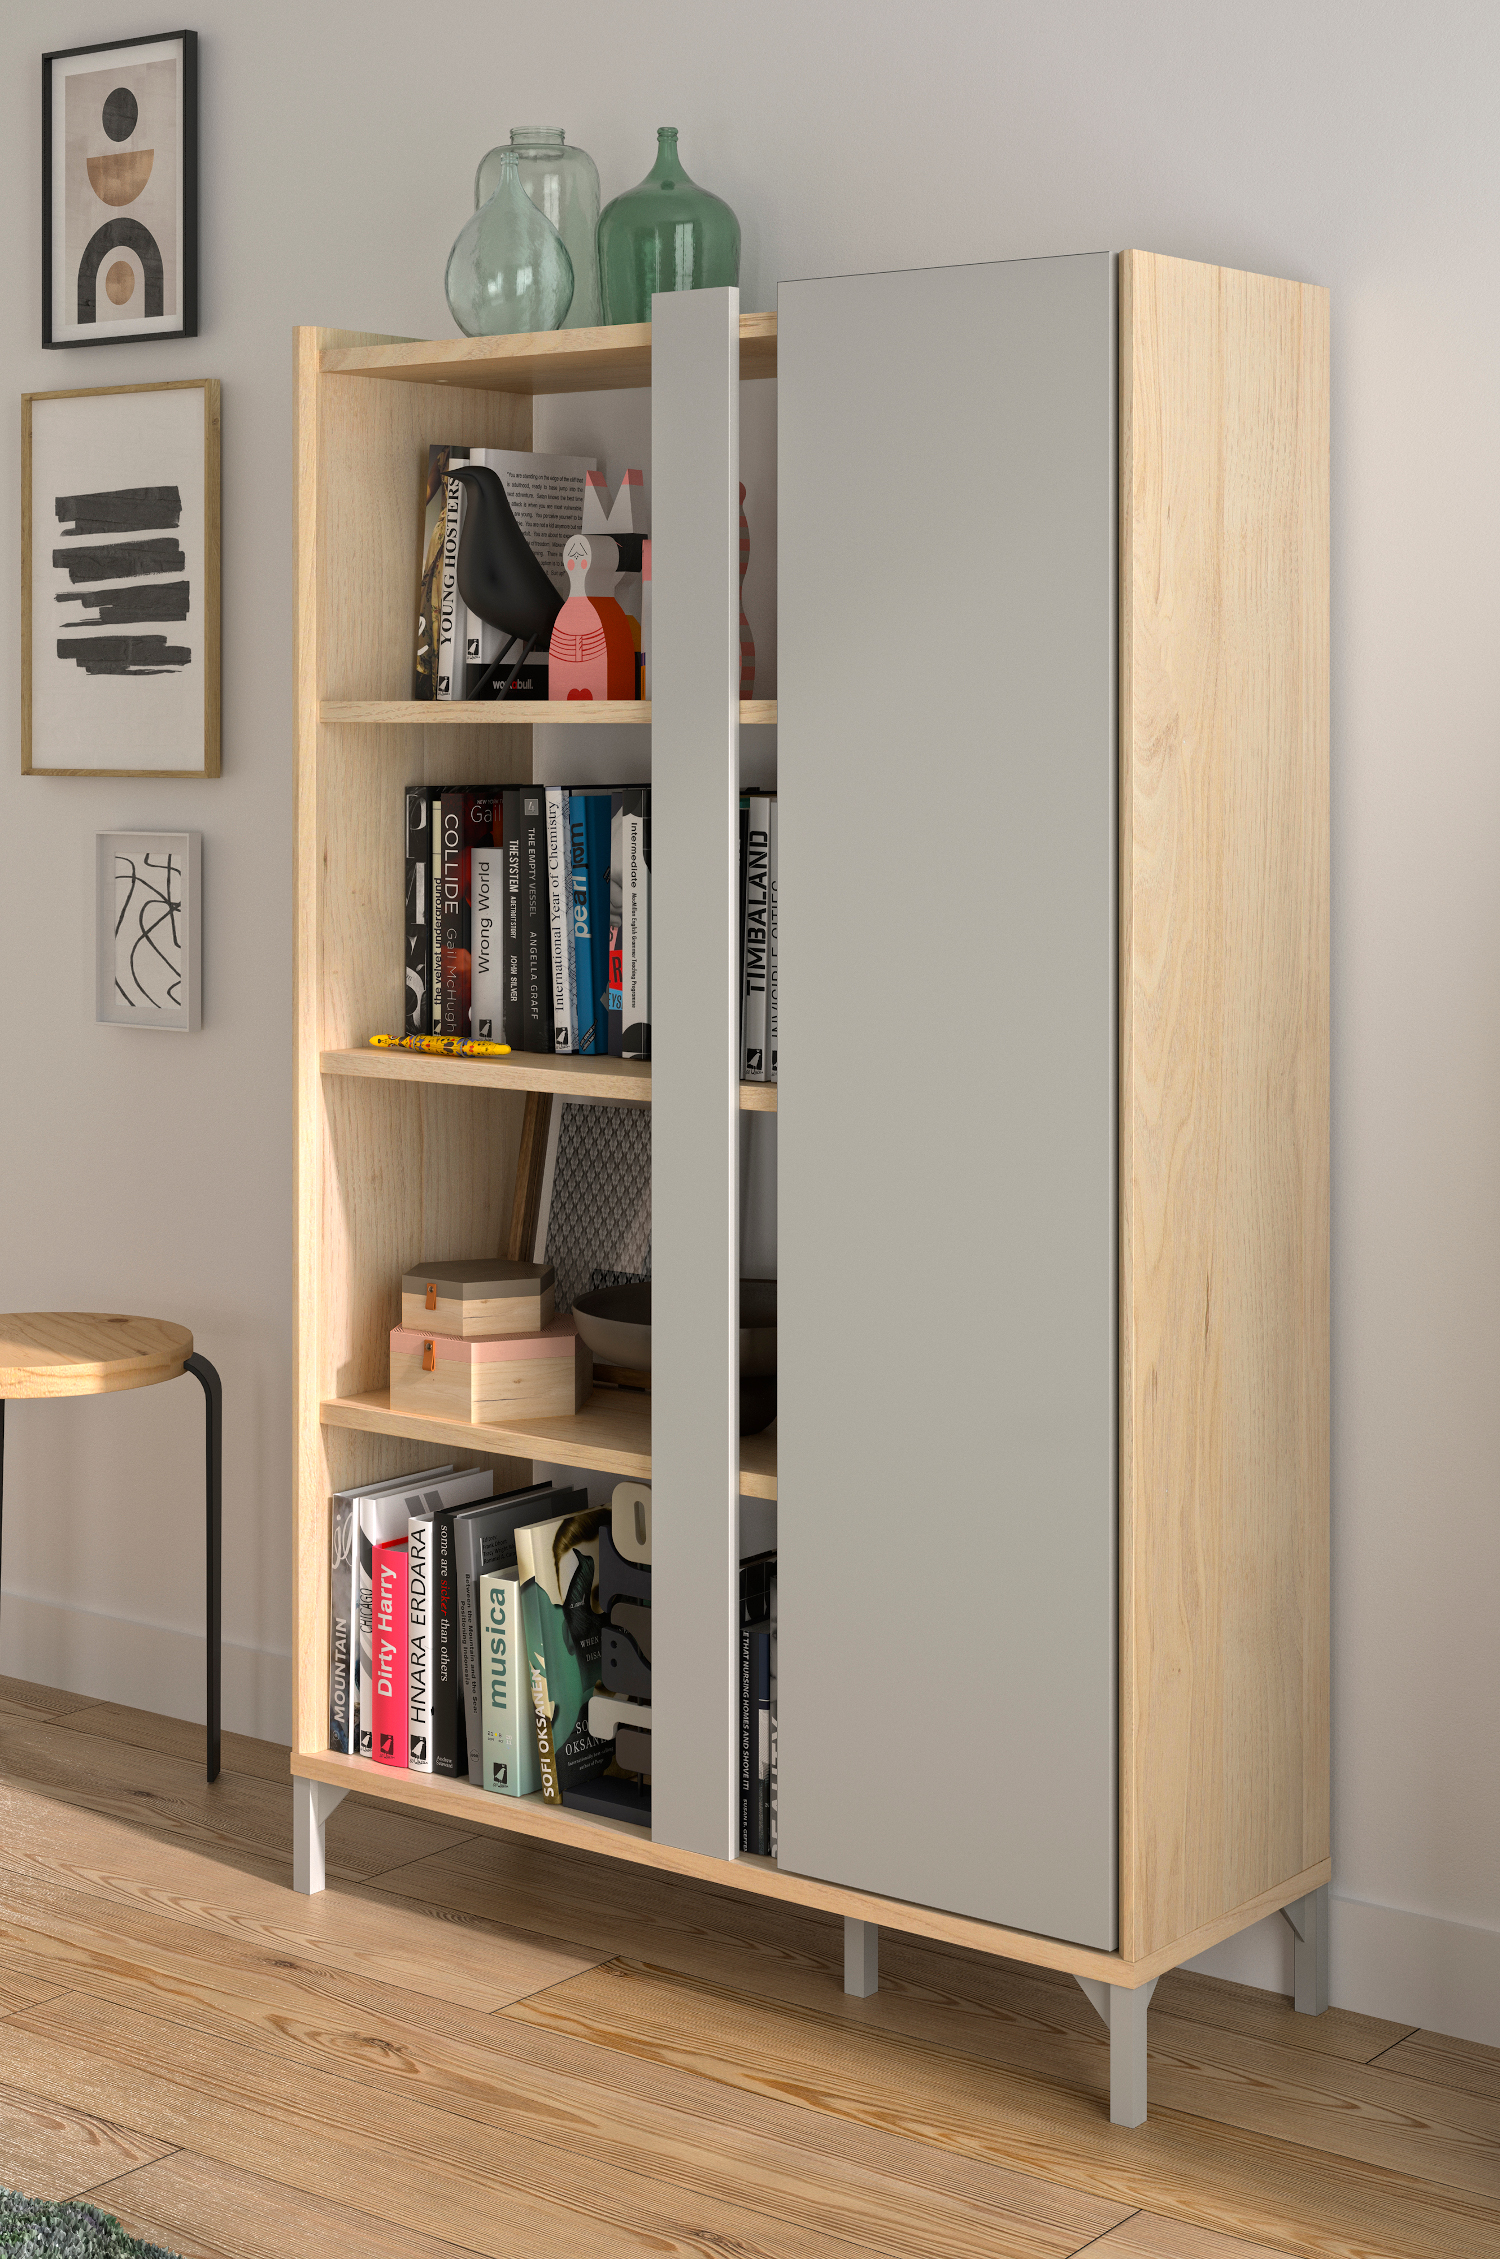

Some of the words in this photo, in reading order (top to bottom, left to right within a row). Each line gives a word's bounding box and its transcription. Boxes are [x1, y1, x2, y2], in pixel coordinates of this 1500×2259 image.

[444, 476, 459, 569] HOSTERS
[440, 574, 456, 646] YOUNG
[492, 678, 534, 690] woabull.
[470, 804, 501, 823] Gail
[509, 840, 519, 856] THE
[528, 828, 536, 846] THE
[548, 801, 560, 870] Chemistry
[570, 822, 589, 870] jam
[444, 813, 459, 914] COLLIDE
[528, 849, 536, 881] EMPTY
[630, 822, 638, 888] Intermediate
[478, 862, 490, 911] World
[509, 857, 519, 893] SYSTEM
[550, 874, 559, 888] of
[528, 882, 537, 917] VESSEL
[551, 892, 560, 922] Year
[571, 876, 592, 939] pearl
[746, 830, 768, 997] TIMBALAND
[446, 928, 458, 959] Gail
[479, 917, 493, 974] Wrong
[529, 931, 538, 981] ANGELLA
[433, 951, 441, 985] velvet
[510, 955, 518, 975] JOHN
[552, 927, 564, 1012] International
[433, 987, 441, 1006] the
[445, 965, 458, 1033] McHugh
[510, 977, 518, 1001] SILVER
[530, 985, 539, 1020] GRAFF
[440, 1524, 448, 1556] some
[410, 1528, 426, 1626] ERDARA
[440, 1558, 448, 1577] are
[360, 1588, 372, 1634] CHICAGO
[377, 1564, 397, 1632] Harry
[440, 1580, 451, 1616] sicker
[440, 1618, 450, 1643] than
[460, 1600, 468, 1645] Positioning
[468, 1624, 476, 1663] Mountain
[486, 1588, 507, 1710] musica
[580, 1635, 600, 1648] WHEN
[586, 1650, 602, 1662] DISA
[742, 1638, 750, 1660] THAT
[333, 1617, 347, 1723] MOUNTAIN
[377, 1638, 397, 1698] Dirty
[410, 1635, 426, 1724] HNARA
[440, 1646, 450, 1682] others
[742, 1661, 750, 1698] NURSING
[530, 1669, 551, 1754] OKSANEN
[575, 1719, 589, 1734] SO
[742, 1699, 750, 1730] HOMES
[742, 1730, 750, 1750] AND
[540, 1758, 555, 1797] SOFI
[742, 1750, 750, 1778] SHOVE
